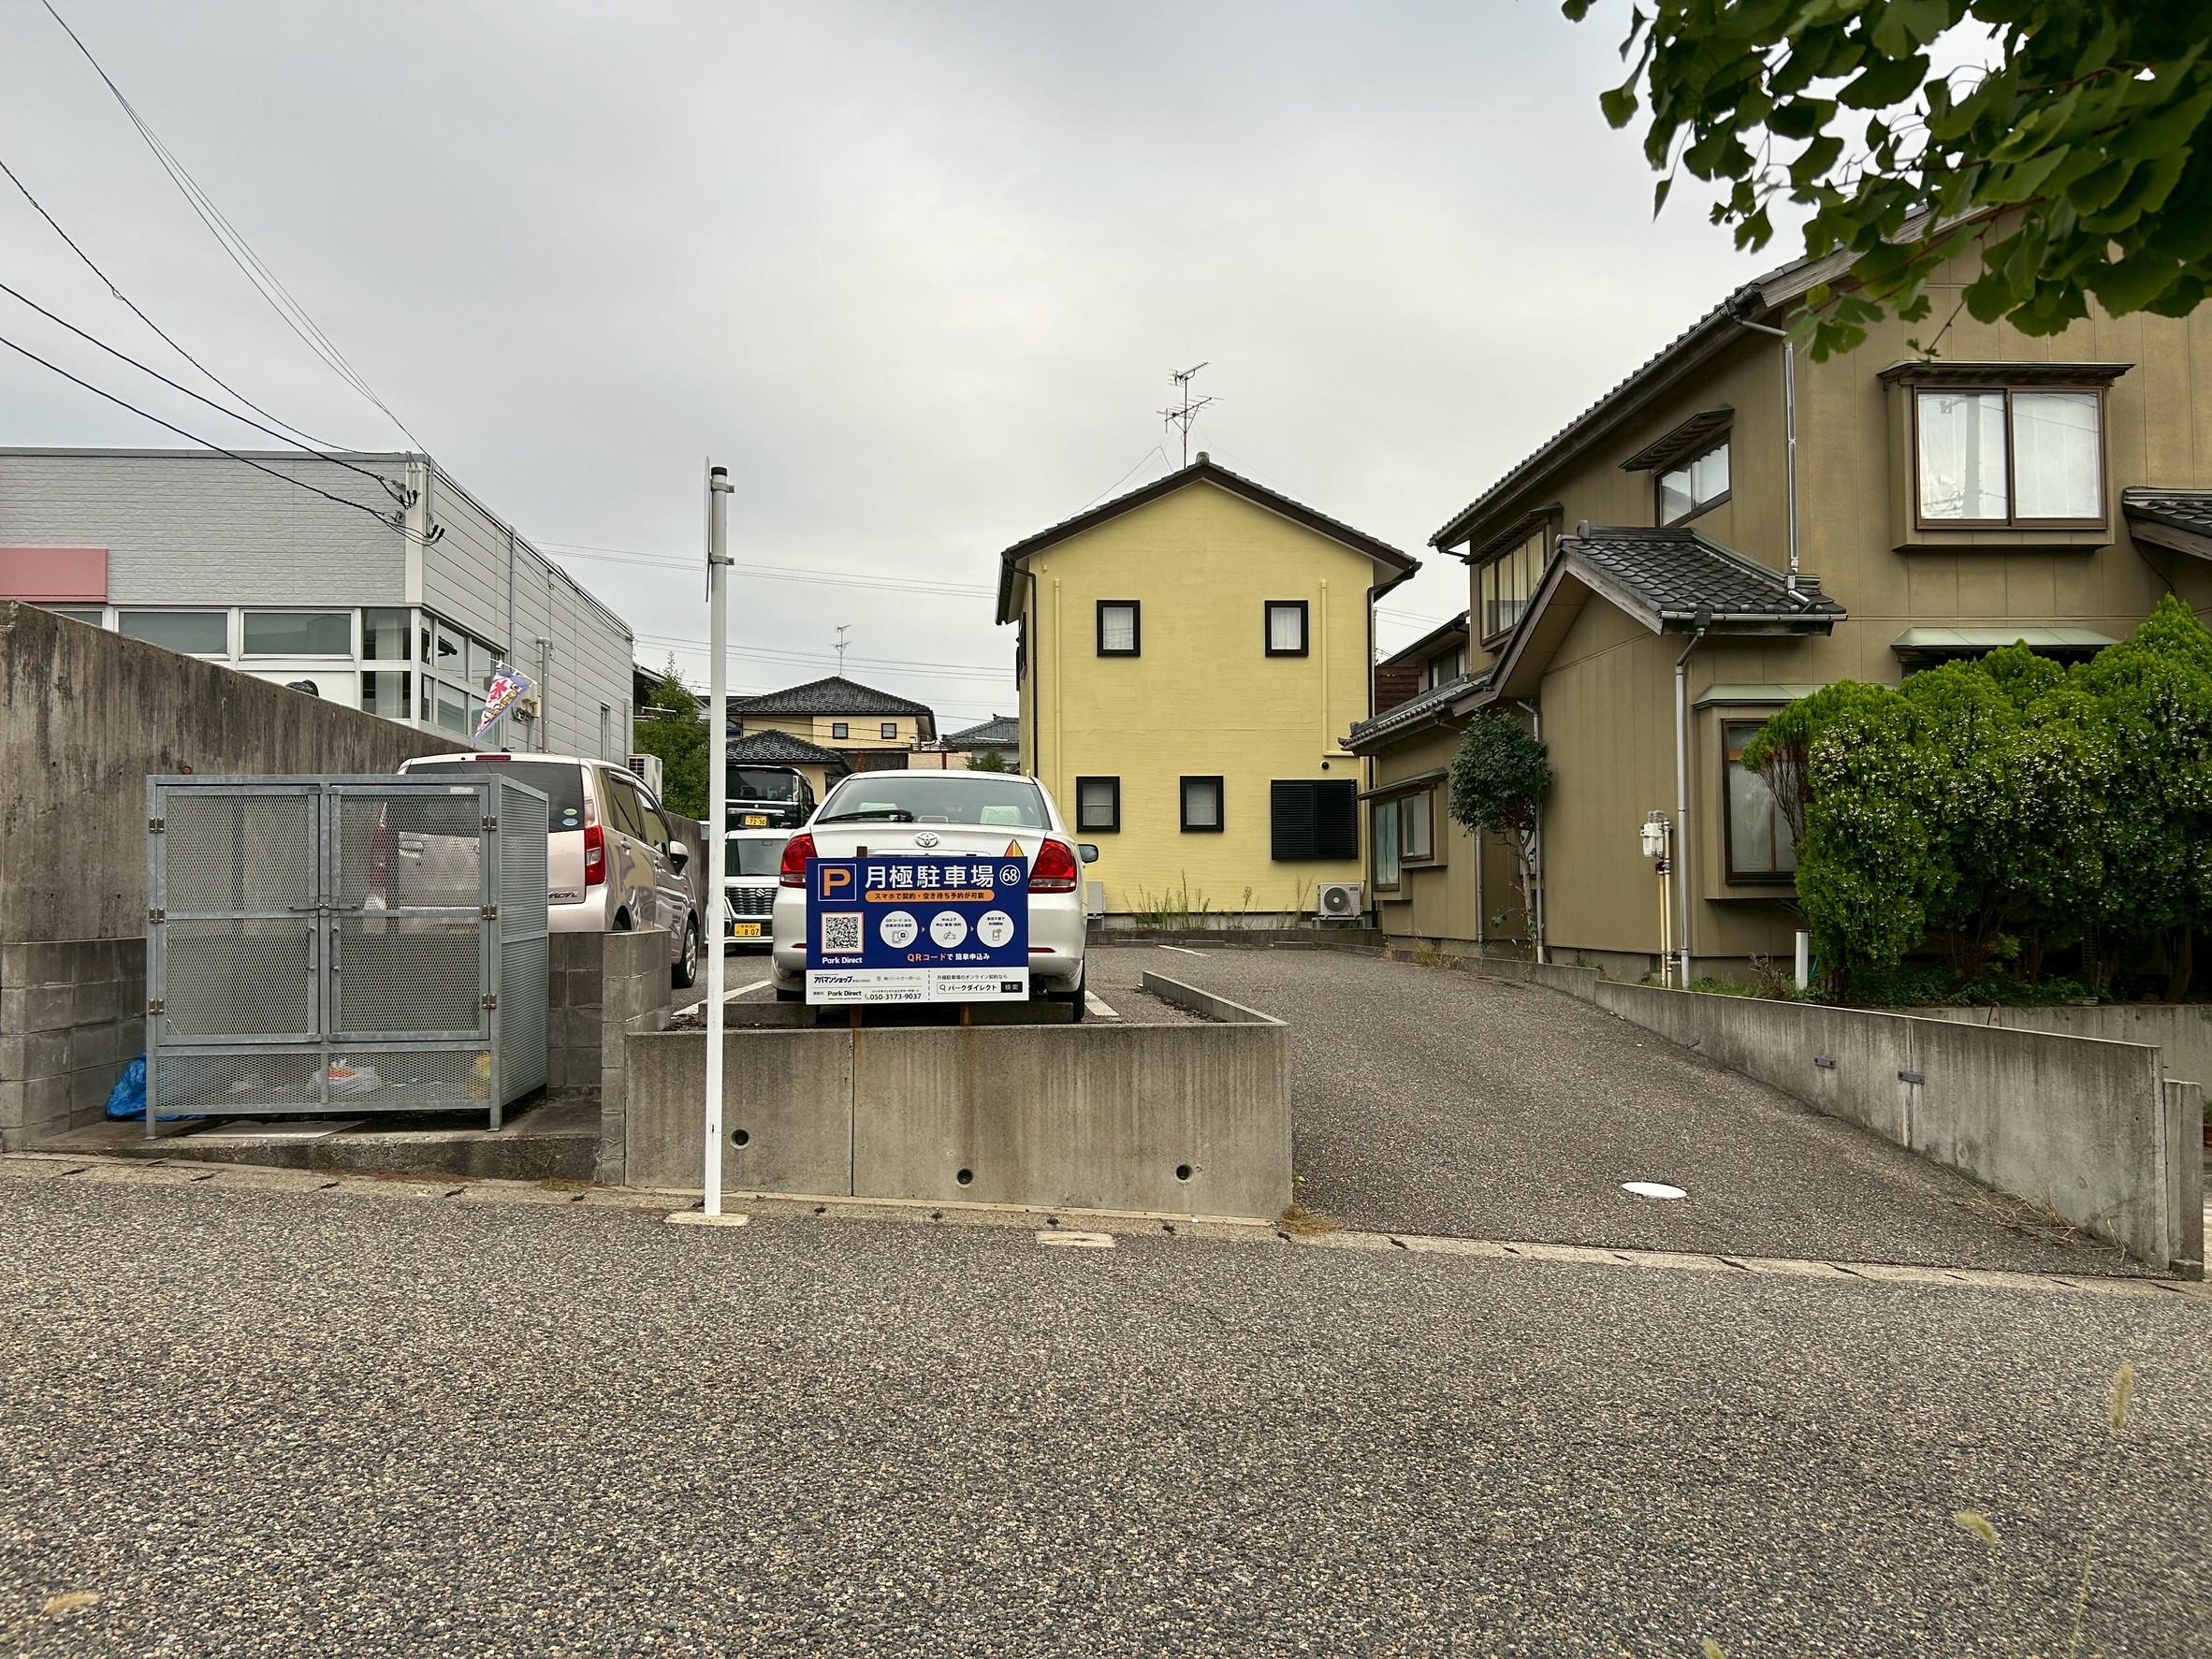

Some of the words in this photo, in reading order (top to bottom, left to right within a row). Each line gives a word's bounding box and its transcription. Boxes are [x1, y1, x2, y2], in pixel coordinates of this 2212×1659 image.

[823, 868, 851, 896] P
[865, 865, 995, 889] 月極駐車場
[907, 953, 953, 962] QRコードで
